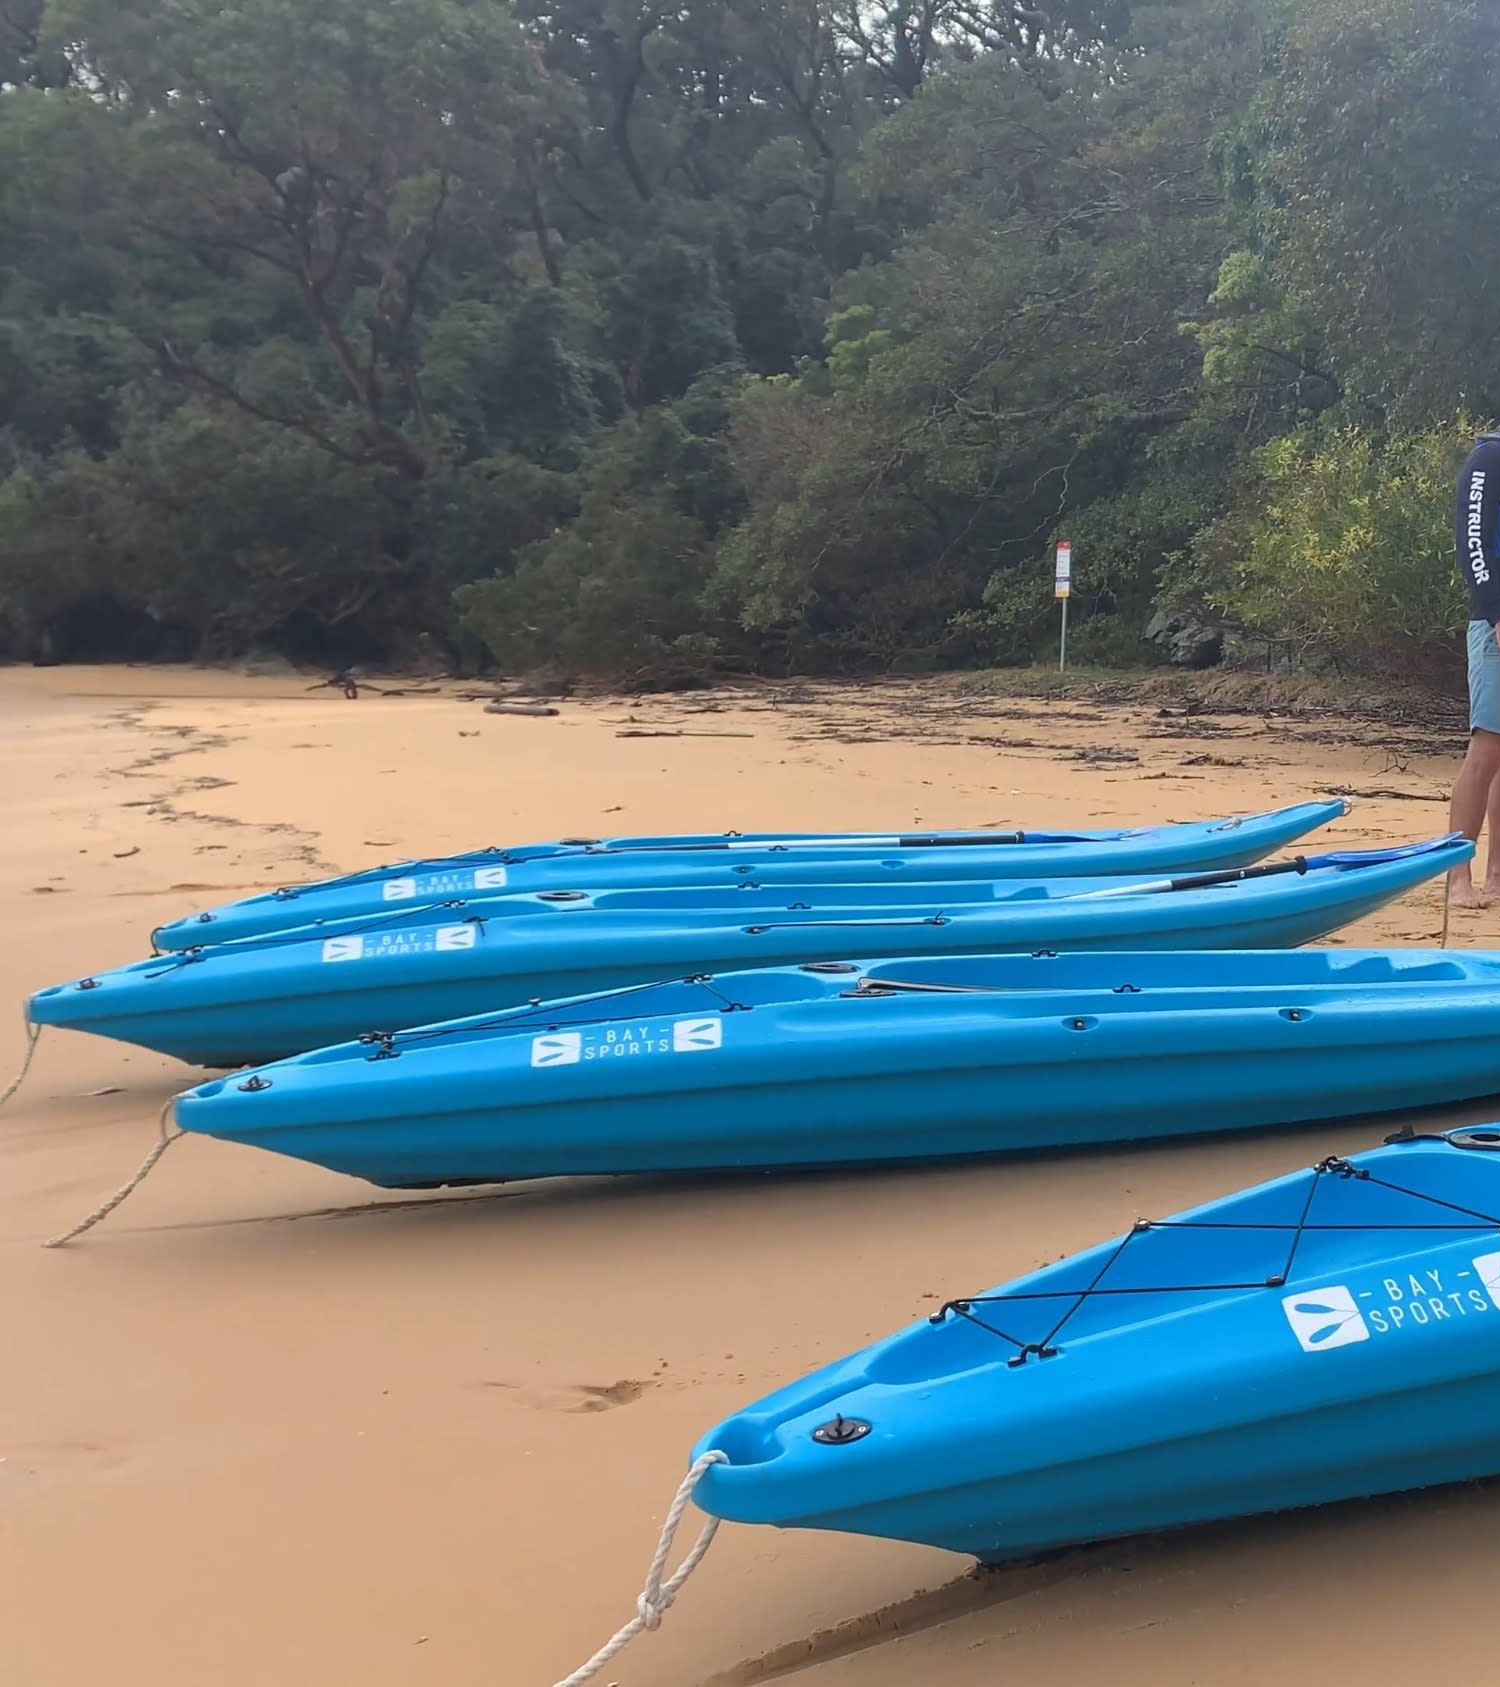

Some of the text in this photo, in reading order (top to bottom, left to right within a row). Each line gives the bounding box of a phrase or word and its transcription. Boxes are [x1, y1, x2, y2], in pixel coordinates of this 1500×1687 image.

[1467, 471, 1490, 585] INSTRUCTOR
[430, 874, 458, 886] BAY
[416, 881, 473, 896] SPORTS
[382, 933, 417, 945] BAY
[364, 942, 433, 957] SPORTS
[606, 1027, 649, 1043] BAY
[584, 1039, 669, 1060] SPORTS
[1383, 1269, 1445, 1301] BAY
[1369, 1289, 1488, 1332] SPORTS
